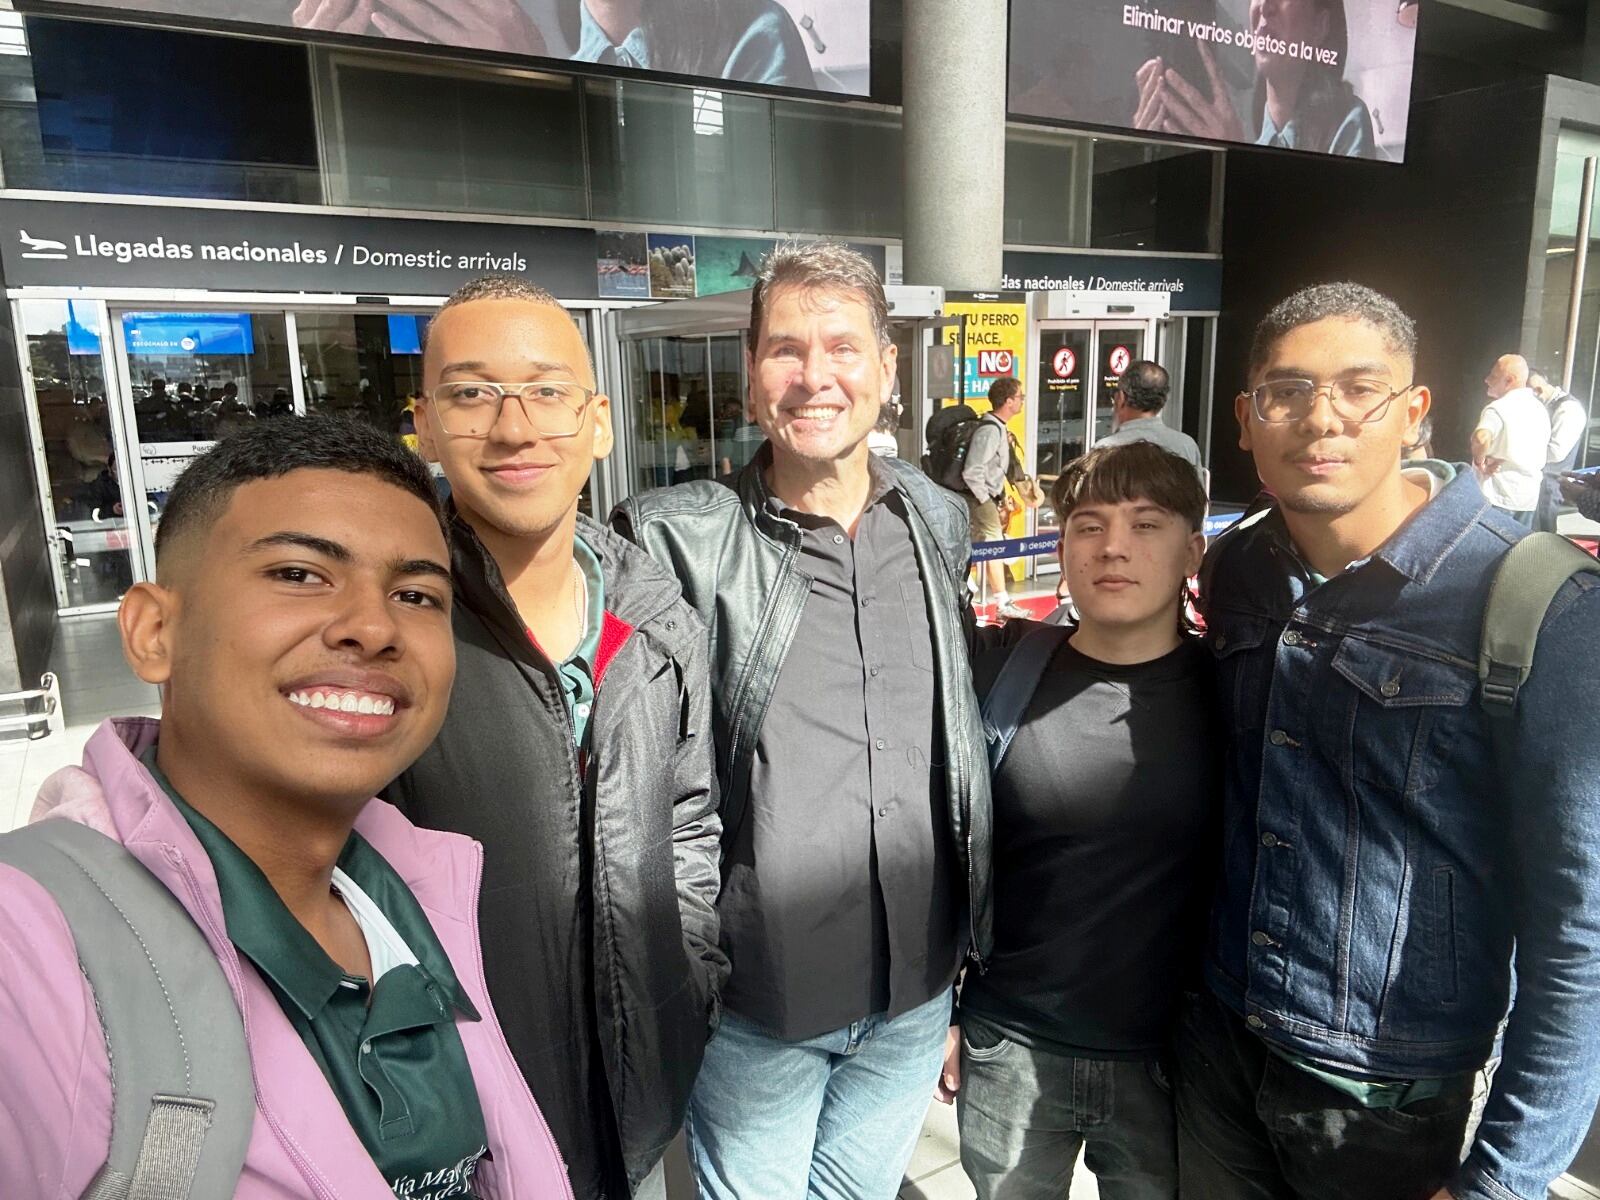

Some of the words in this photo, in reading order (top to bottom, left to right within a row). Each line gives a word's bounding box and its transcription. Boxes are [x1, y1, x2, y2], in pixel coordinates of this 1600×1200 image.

[1123, 5, 1184, 35] Eliminar
[1187, 21, 1233, 44] varios
[1235, 29, 1287, 55] objetos
[1288, 43, 1298, 57] a
[1300, 41, 1314, 60] la
[1315, 47, 1338, 66] vez
[74, 234, 194, 263] Llegadas
[201, 241, 328, 264] nacionales
[334, 244, 344, 265] /
[352, 245, 452, 268] Domestic
[457, 252, 527, 272] arrivals
[1024, 275, 1085, 290] nacionales
[1088, 276, 1094, 291] /
[1096, 277, 1145, 291] Domestic
[1149, 279, 1184, 292] arrivals
[981, 313, 1019, 326] PERRO
[980, 350, 1012, 373] NO
